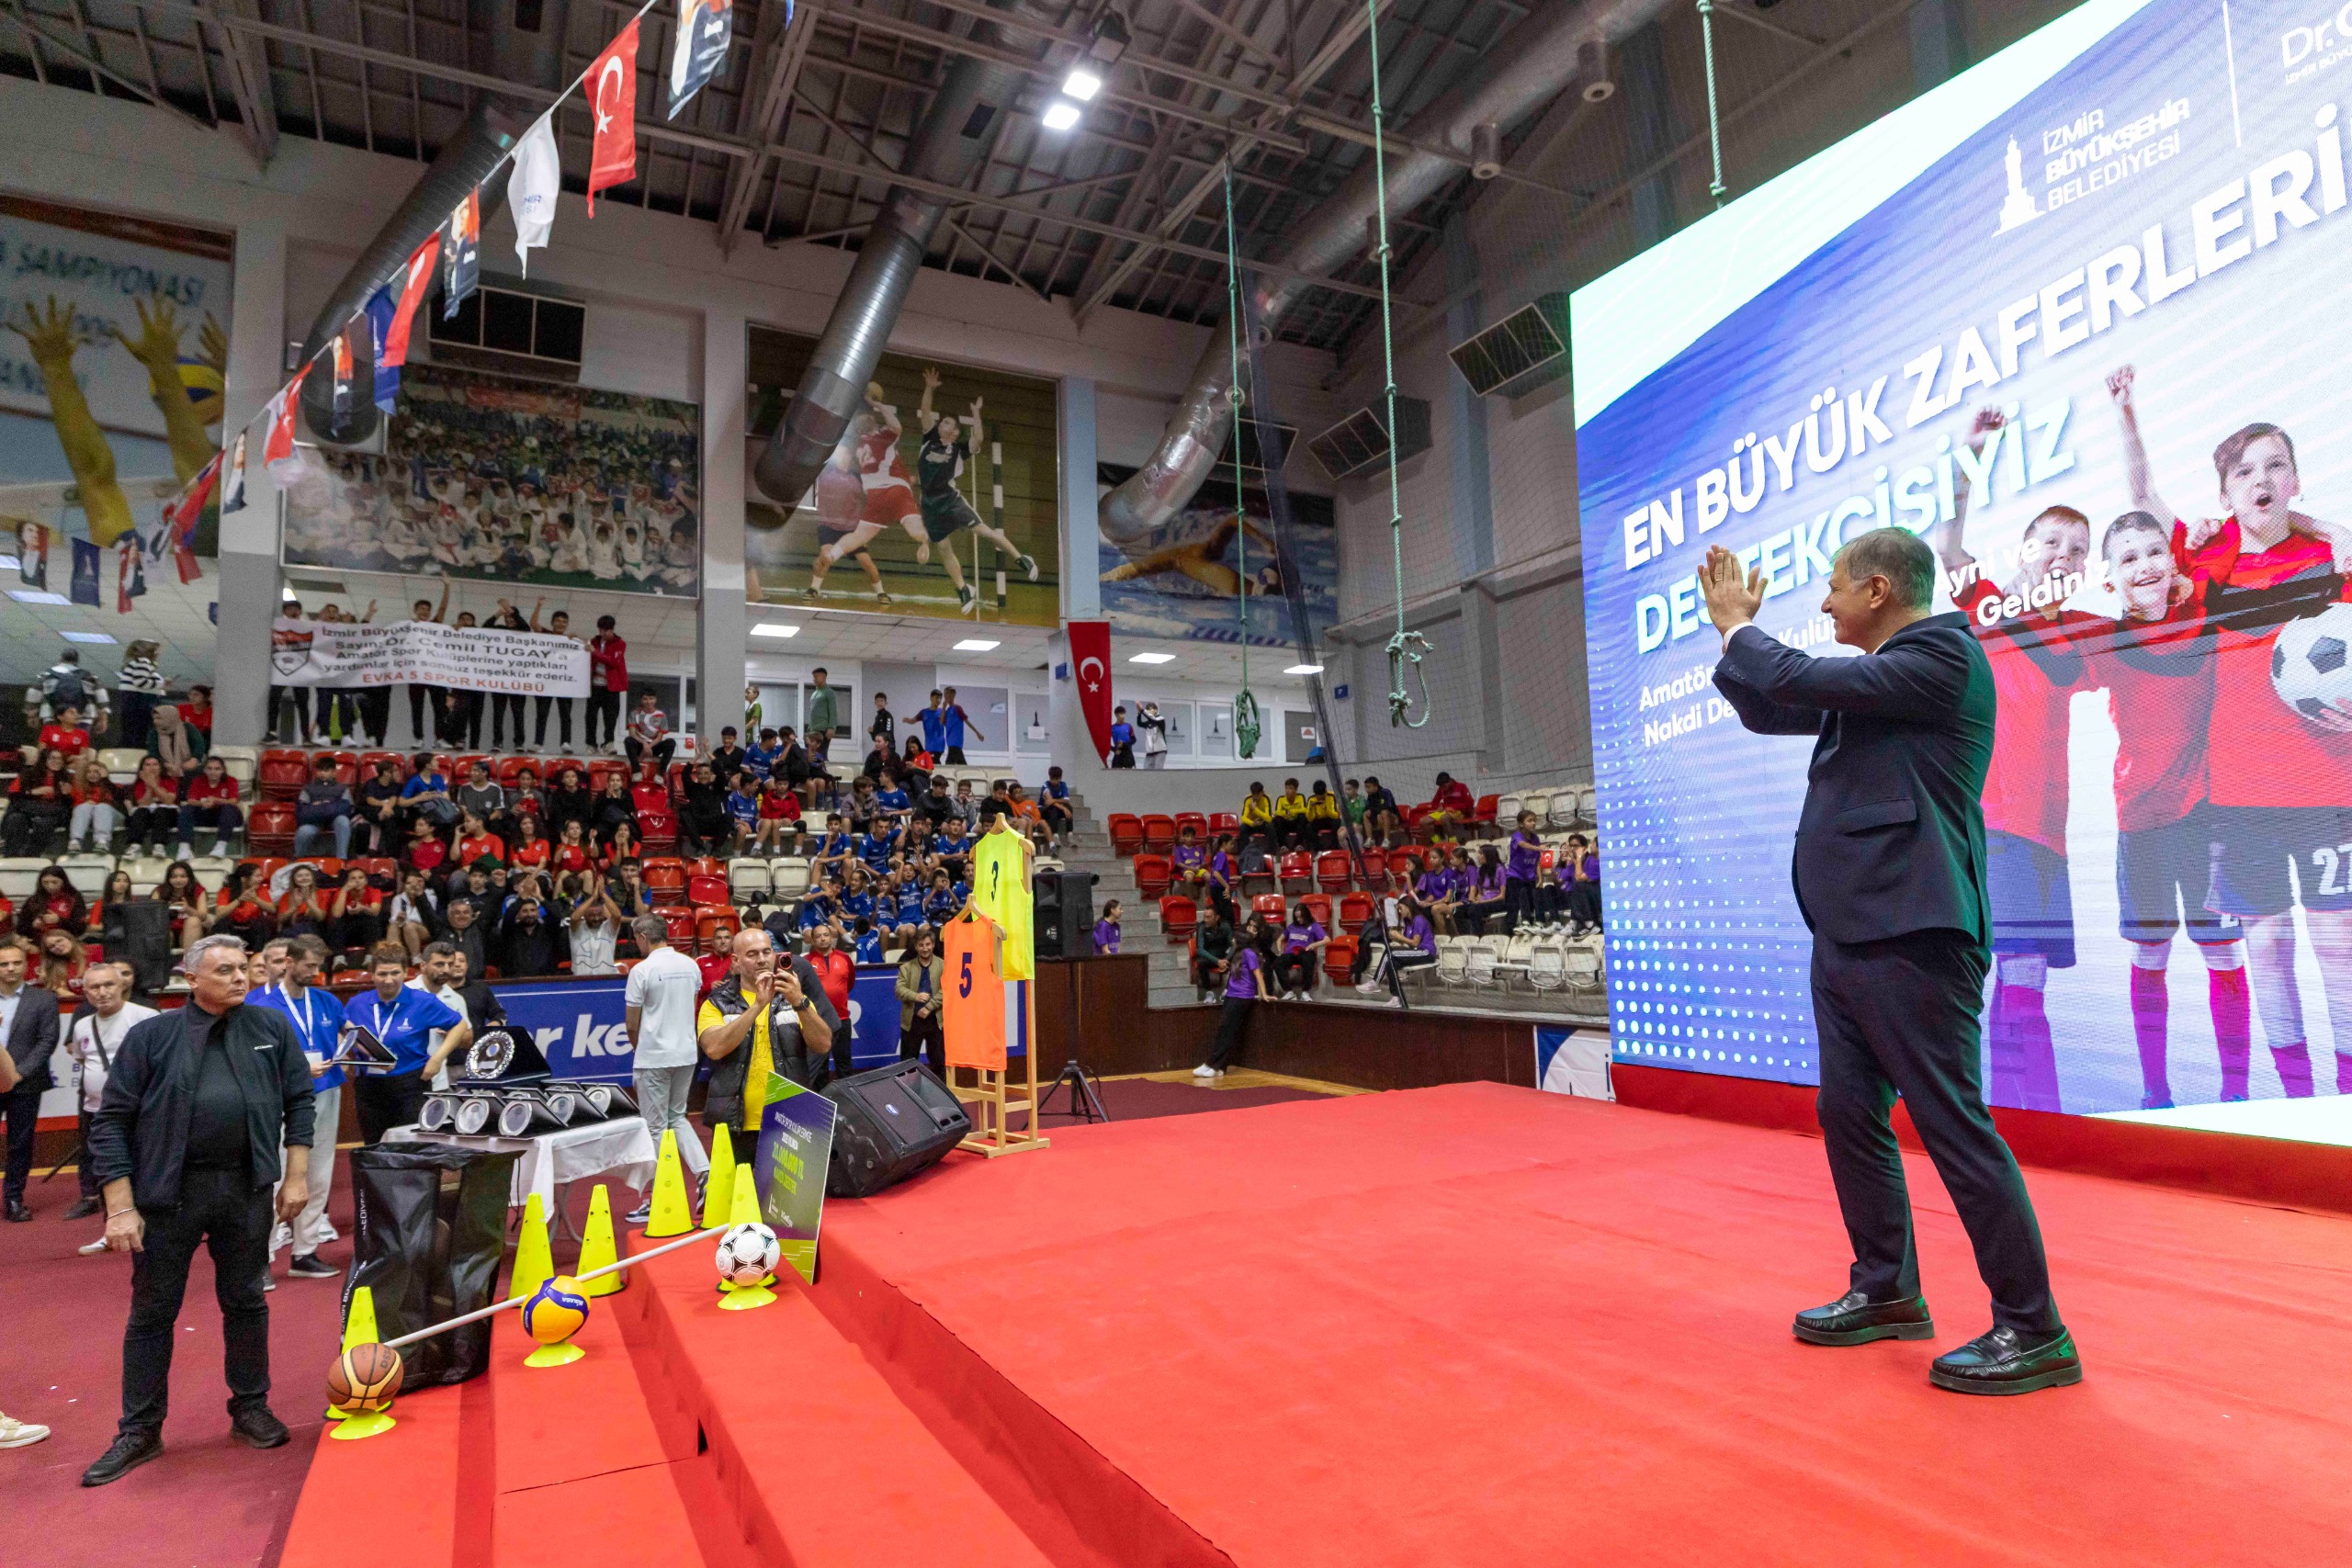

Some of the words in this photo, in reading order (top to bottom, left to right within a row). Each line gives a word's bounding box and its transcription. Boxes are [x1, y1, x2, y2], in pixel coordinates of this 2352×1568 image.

[2043, 107, 2105, 155] İZMİR
[2045, 97, 2190, 184] BÜYÜKŞEHİR
[2047, 129, 2180, 212] BELEDİYESİ
[1623, 488, 1684, 571] EN
[1696, 386, 1893, 535] BÜYÜK
[1904, 103, 2352, 429] ZAFERLERİ
[386, 637, 410, 646] Dr.
[418, 637, 475, 652] Cemil
[443, 629, 501, 643] Belediye
[505, 636, 580, 650] Başkanımız
[1639, 665, 1716, 712] Amatör
[1779, 614, 1838, 650] Kulü
[2003, 537, 2041, 567] ve
[336, 649, 387, 660] Amatör
[391, 649, 421, 657] Spor
[426, 649, 503, 665] Kulüplerine
[508, 660, 568, 671] yaptıkları
[393, 660, 415, 668] için
[421, 660, 469, 673] sonsuz
[474, 667, 531, 679] teşekkür
[536, 672, 577, 682] ederiz.
[1645, 703, 1702, 747] Nakdi
[1708, 697, 1736, 725] De
[1977, 557, 2110, 627] Geldiniz
[363, 671, 403, 682] EVKA
[410, 671, 417, 680] 5
[424, 672, 470, 686] SPOR
[476, 679, 545, 693] KULÜBÜ
[958, 952, 972, 998] 5
[528, 1027, 563, 1058] r
